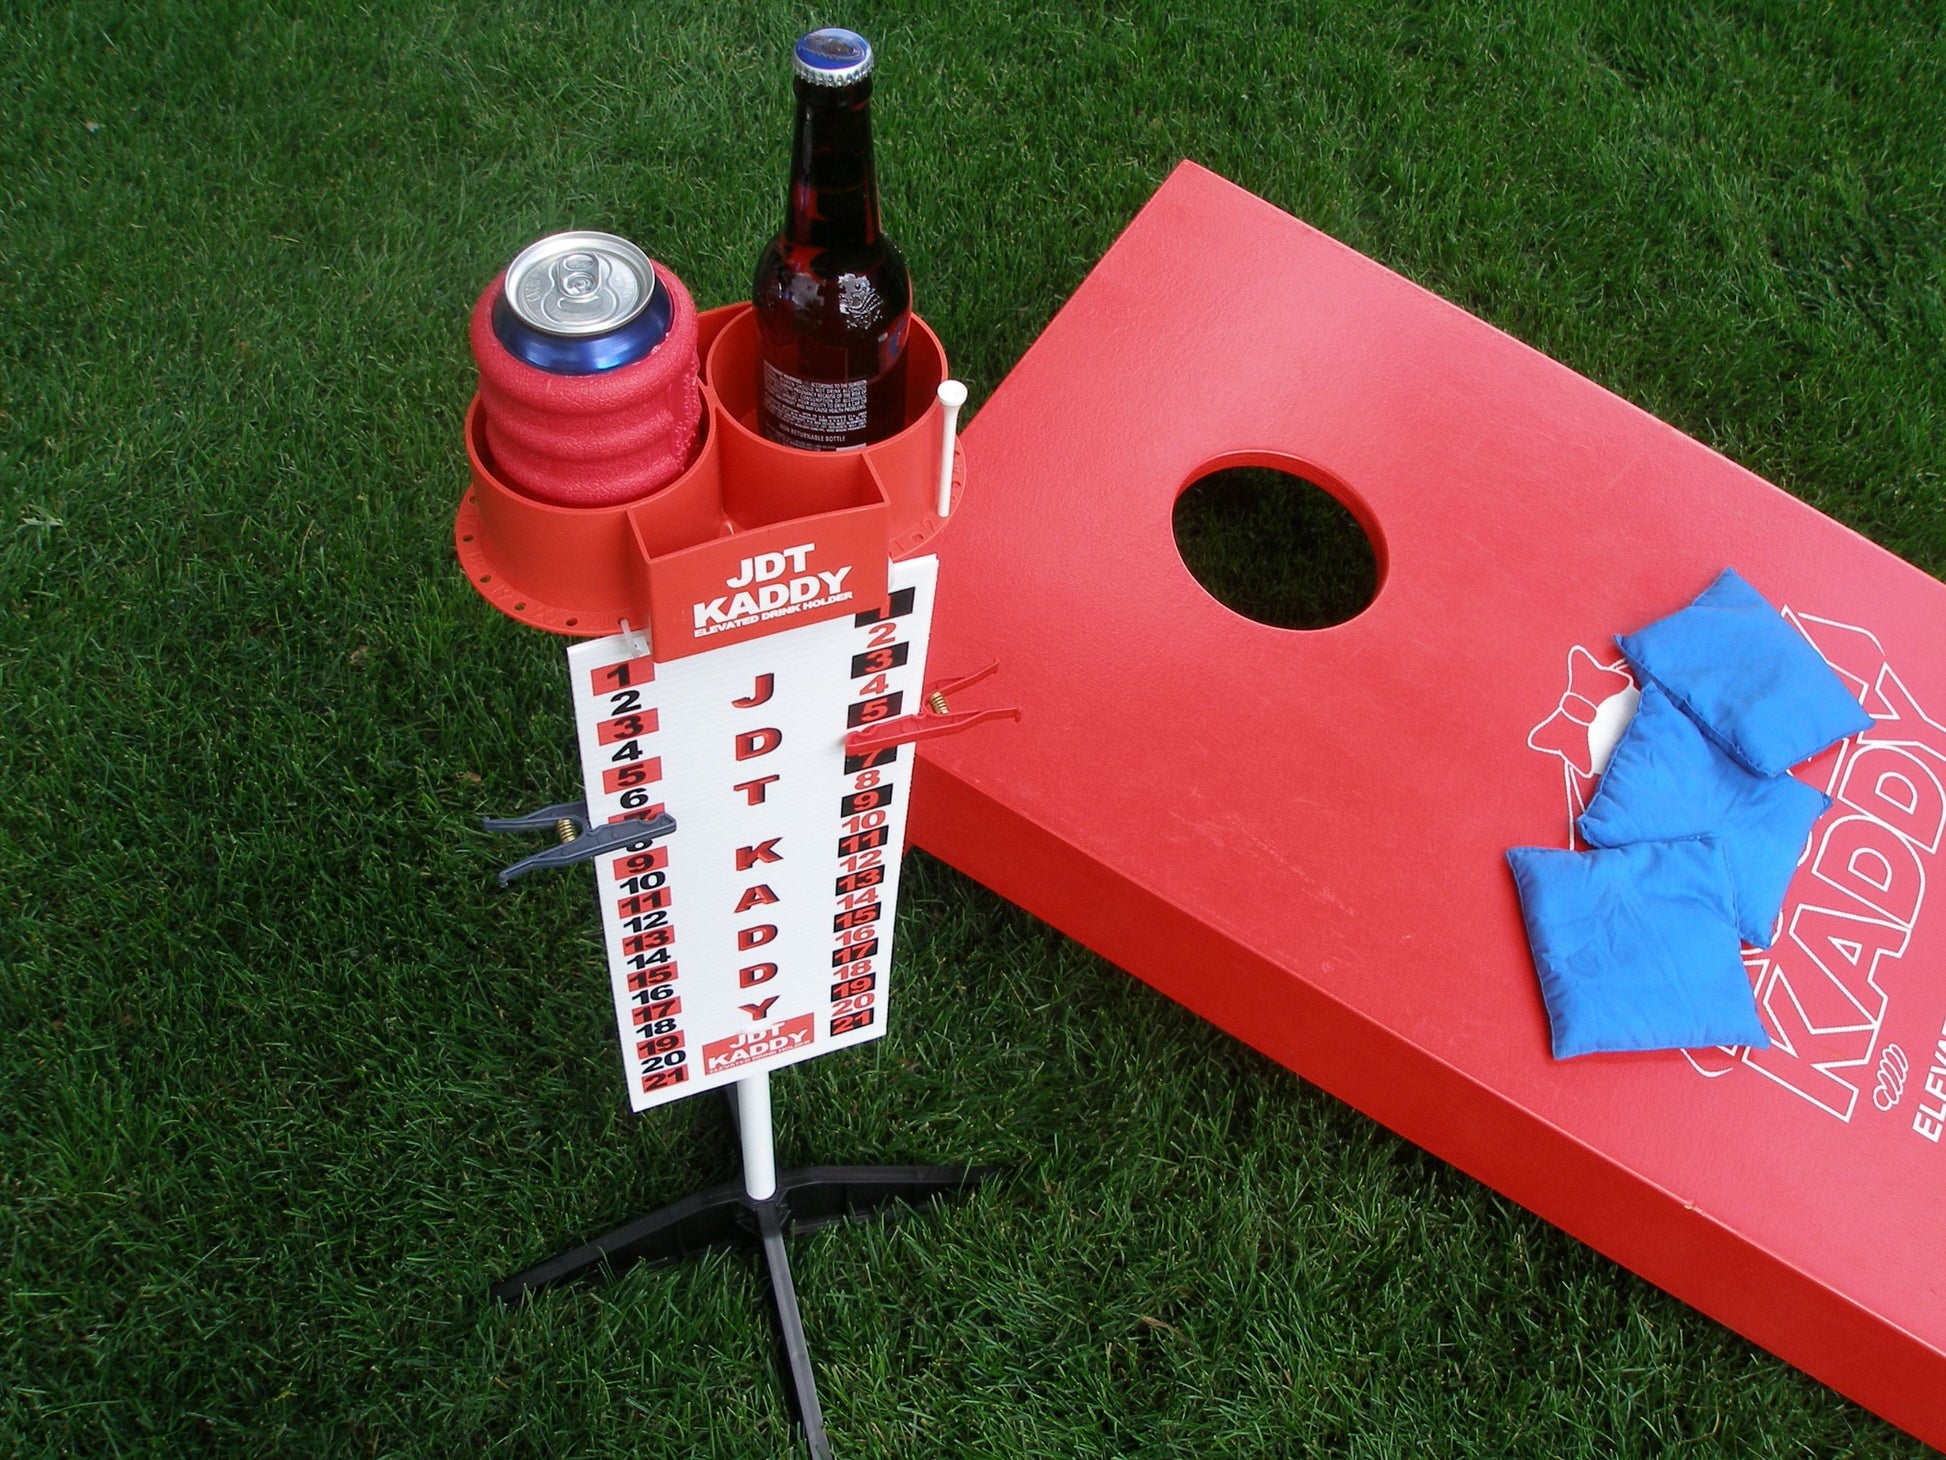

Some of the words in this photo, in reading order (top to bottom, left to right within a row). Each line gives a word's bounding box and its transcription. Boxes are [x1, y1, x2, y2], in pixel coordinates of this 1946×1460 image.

[791, 428, 824, 441] RETURNABLE
[726, 543, 816, 589] JDT
[693, 566, 853, 630] KADDY
[694, 615, 759, 639] ELEVATED
[762, 602, 801, 621] DRINK
[803, 591, 853, 611] HOLDER
[867, 622, 897, 649] 2
[865, 649, 893, 673] 3
[606, 663, 630, 687] 1
[859, 673, 889, 696] 4
[610, 690, 642, 716] 2
[861, 698, 888, 723] 5
[614, 715, 644, 740] 3
[612, 740, 643, 762] 4
[731, 673, 783, 807] JDT
[858, 748, 883, 769] 7
[618, 763, 646, 787] 5
[854, 770, 880, 791] 8
[620, 788, 648, 809] 6
[853, 791, 879, 812] 9
[841, 810, 887, 834] 10
[842, 830, 880, 854] 11
[627, 854, 654, 874] 9
[839, 850, 882, 872] 12
[620, 871, 666, 895] 10
[838, 869, 881, 892] 13
[1741, 661, 1946, 1123] KADDY
[621, 891, 661, 915] 11
[836, 887, 879, 911] 14
[623, 911, 668, 933] 12
[734, 836, 784, 1021] KADDY
[836, 906, 877, 928] 15
[625, 930, 669, 953] 13
[835, 924, 875, 946] 16
[627, 948, 671, 970] 14
[834, 942, 874, 964] 17
[629, 966, 672, 988] 15
[832, 960, 872, 981] 18
[632, 984, 674, 1005] 16
[833, 977, 871, 999] 19
[634, 999, 676, 1022] 17
[831, 992, 875, 1017] 20
[636, 1018, 677, 1038] 18
[833, 1010, 871, 1034] 21
[639, 1036, 678, 1056] 19
[729, 1022, 785, 1049] JDT
[708, 1028, 808, 1070] KADDY
[641, 1050, 686, 1074] 20
[645, 1069, 684, 1091] 21
[1912, 1016, 1946, 1143] ELEV
